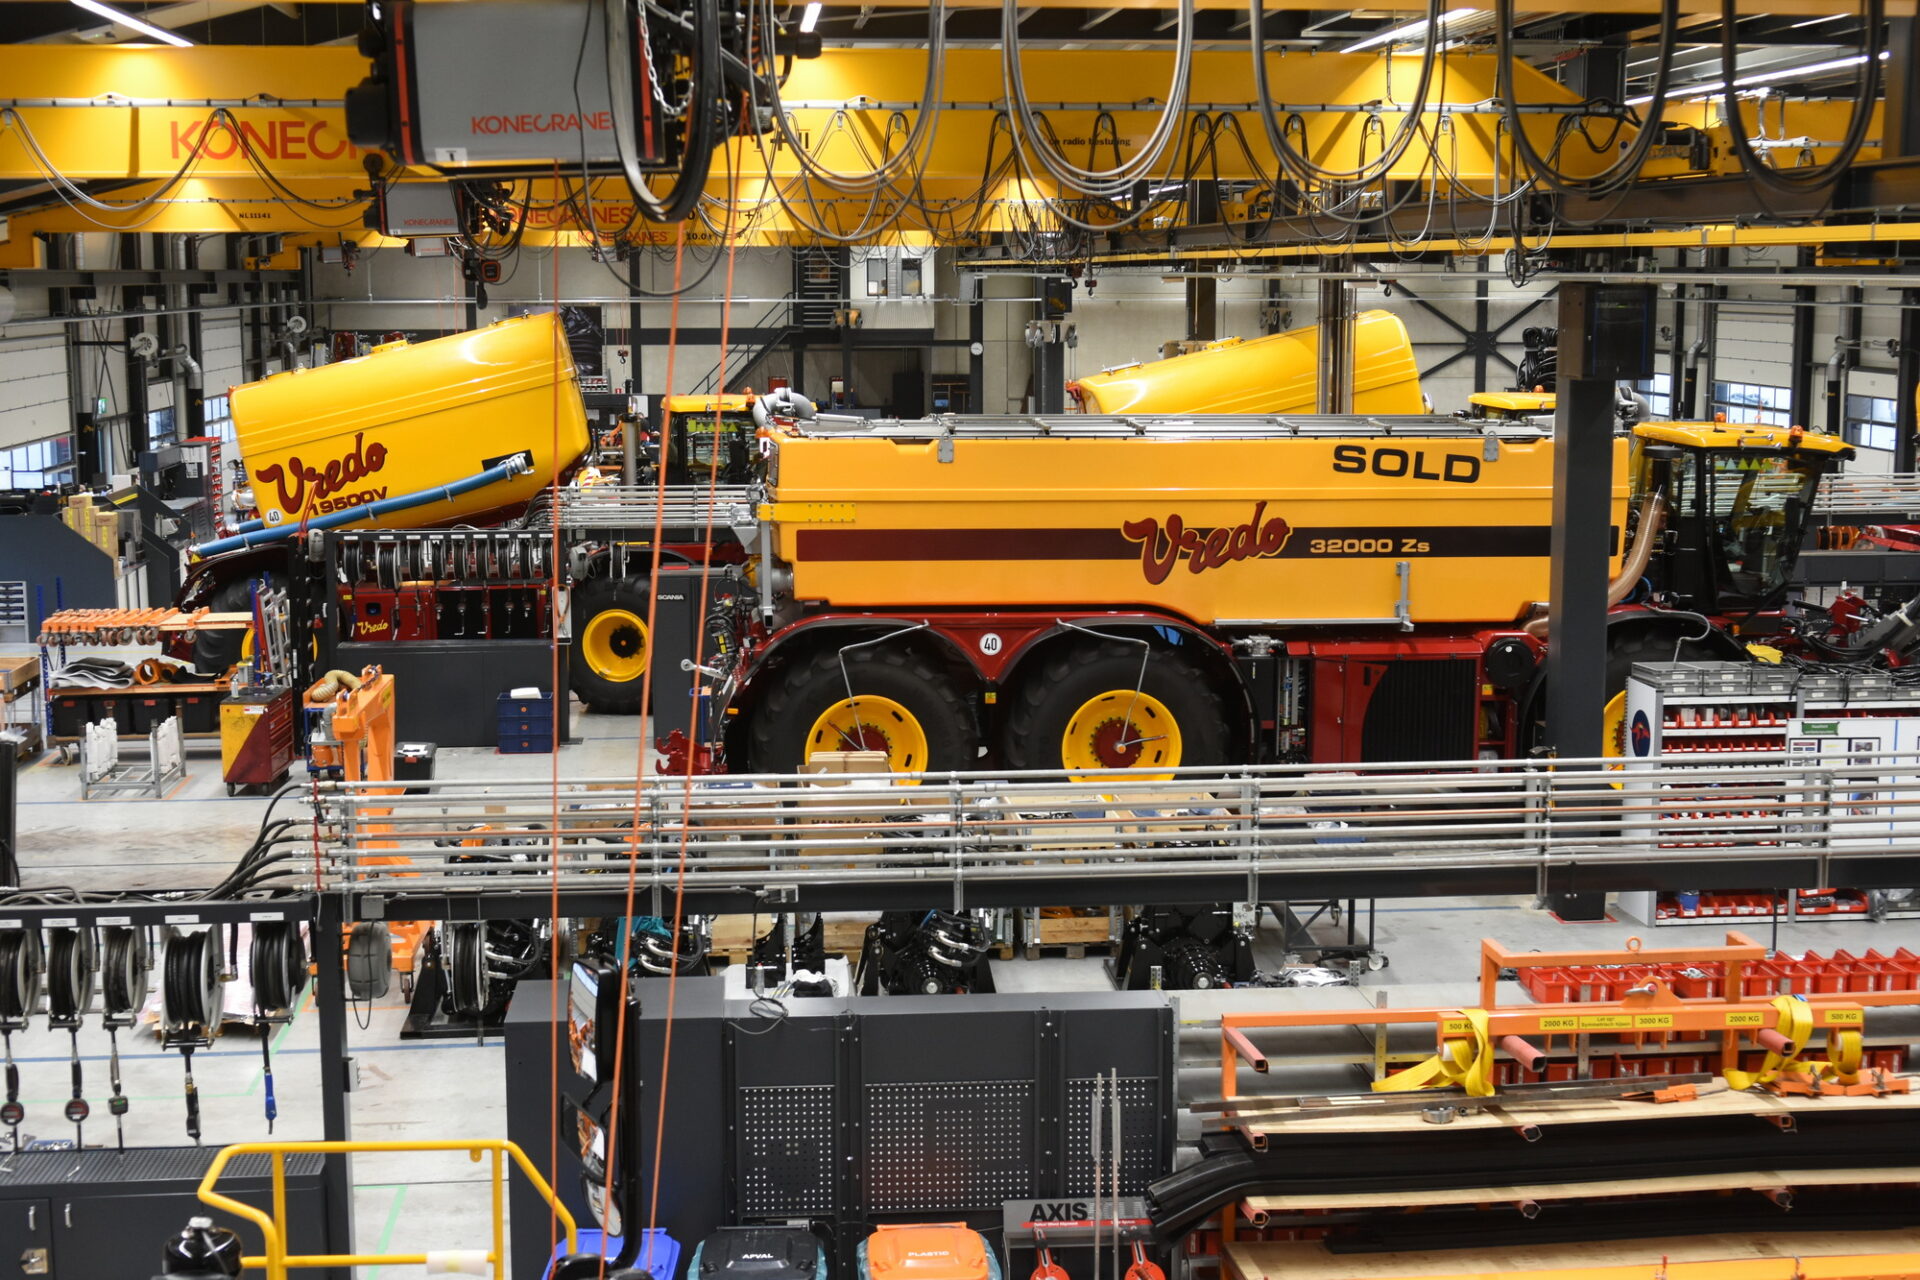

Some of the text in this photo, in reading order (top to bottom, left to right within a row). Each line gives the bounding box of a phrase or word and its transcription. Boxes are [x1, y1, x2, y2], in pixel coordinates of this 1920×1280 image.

[471, 112, 615, 135] KONECRANE
[578, 231, 668, 243] KONERANES
[1333, 444, 1481, 484] SOLD
[255, 431, 388, 515] Vredo
[268, 510, 281, 523] 40
[1121, 500, 1293, 585] Vredo
[1310, 539, 1431, 554] 32000 Zs
[357, 619, 389, 635] Vredo
[984, 637, 998, 651] 40
[1639, 1017, 1669, 1026] 3000 KG
[1730, 1015, 1760, 1023] 2000 KG
[1831, 1012, 1857, 1021] 500 KG
[1449, 1022, 1462, 1030] 500
[1543, 1019, 1575, 1028] 2000 KG
[1030, 1202, 1088, 1222] AXIS
[907, 1250, 949, 1258] PLASTIC
